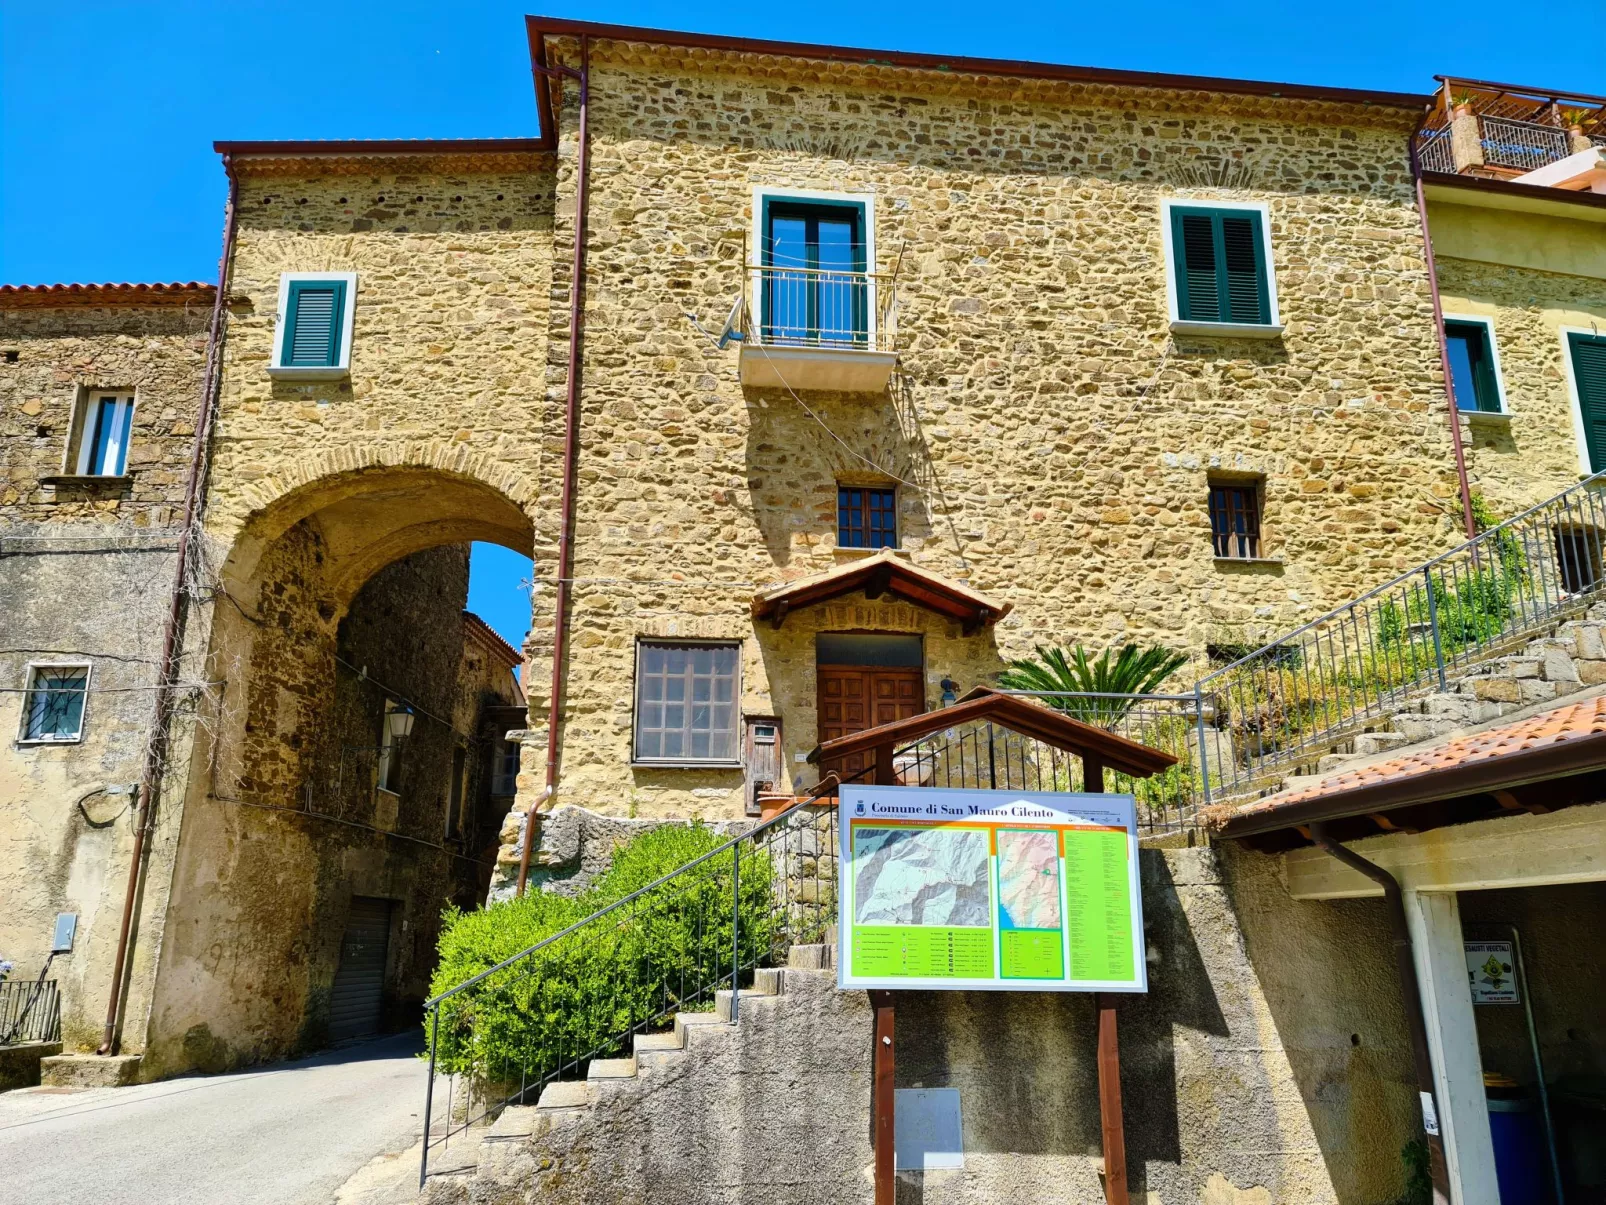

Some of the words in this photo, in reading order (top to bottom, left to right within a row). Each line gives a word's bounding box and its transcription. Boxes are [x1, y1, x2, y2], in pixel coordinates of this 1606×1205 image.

[871, 801, 922, 815] Comune
[926, 803, 937, 815] di
[940, 803, 963, 816] San
[966, 803, 1009, 817] Mauro
[1011, 805, 1054, 819] Cilento
